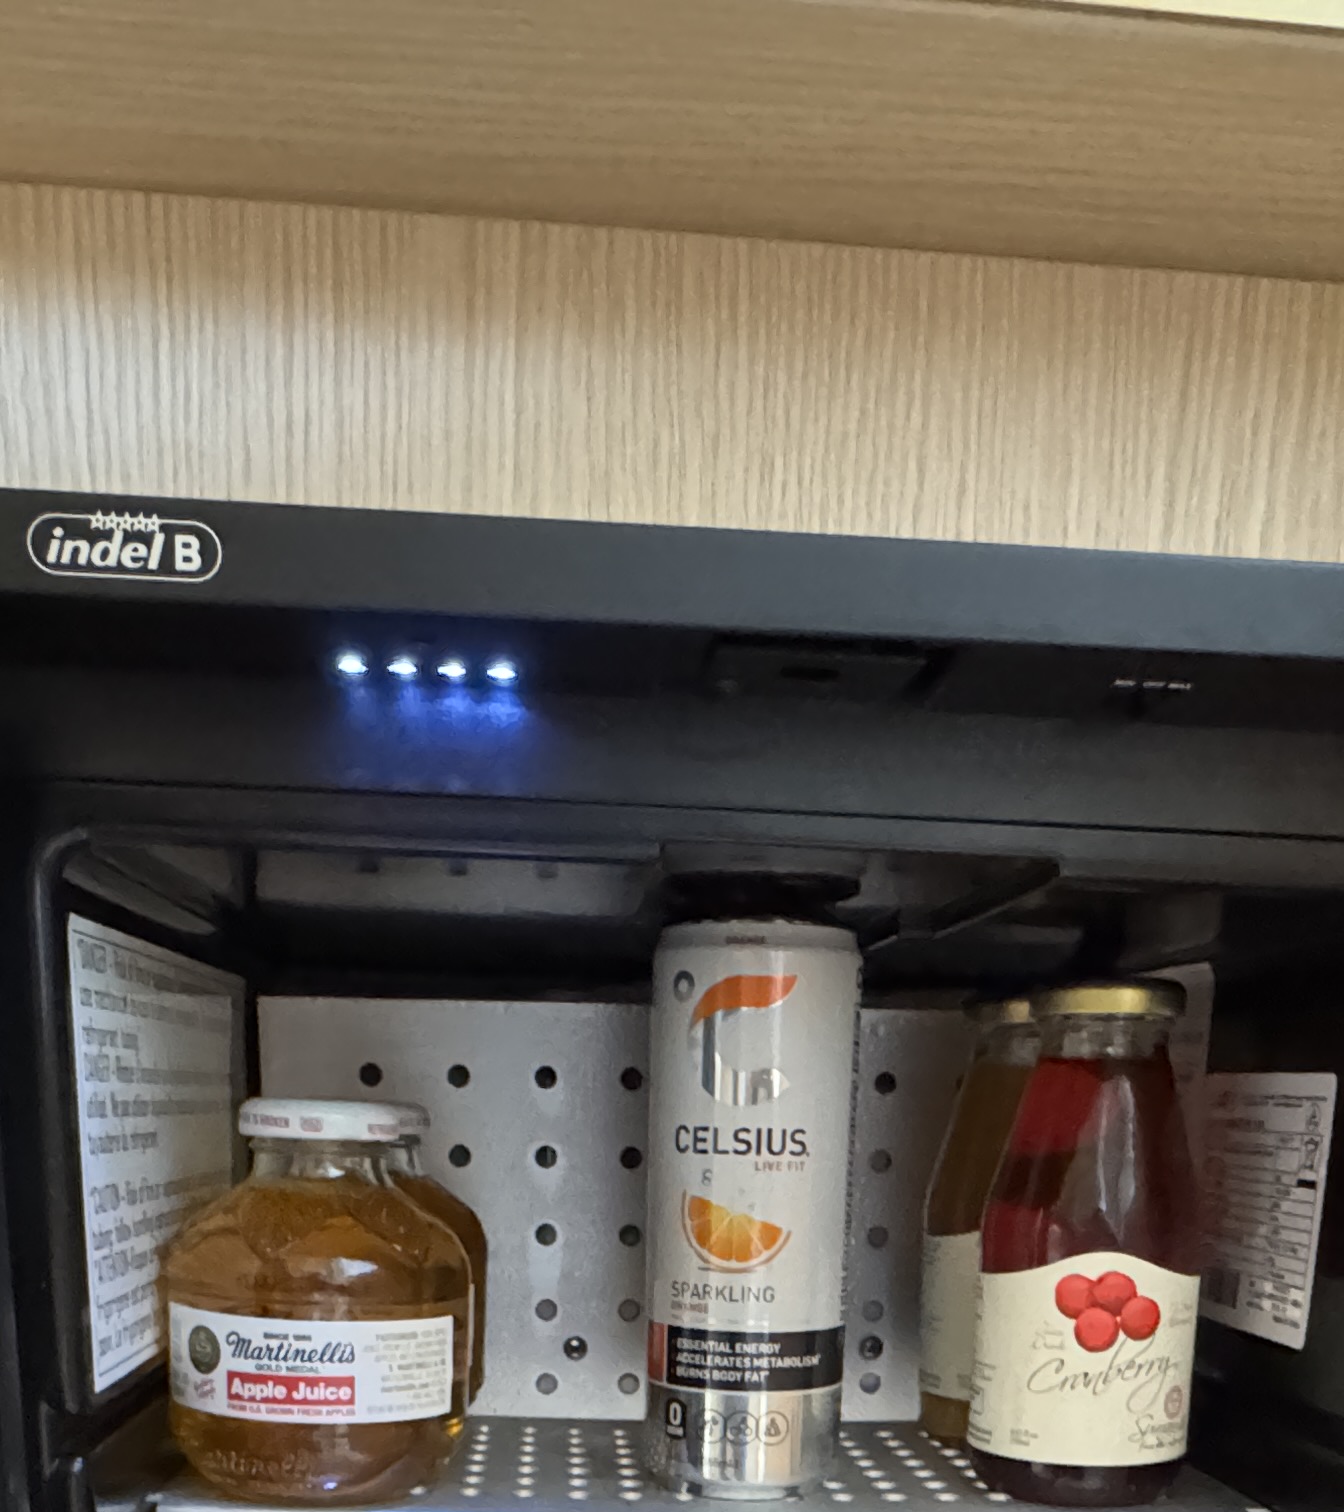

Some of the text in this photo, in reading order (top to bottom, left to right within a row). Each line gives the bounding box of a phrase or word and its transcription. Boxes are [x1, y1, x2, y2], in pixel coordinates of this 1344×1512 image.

[46, 526, 202, 571] indel B
[674, 1124, 808, 1157] CELSIUS
[754, 1161, 806, 1172] LIVE FIT
[671, 1280, 775, 1303] SPARKLING
[734, 1342, 781, 1354] ENERGY
[711, 1369, 743, 1383] BODY
[230, 1377, 288, 1401] Apple
[291, 1381, 353, 1401] Juice
